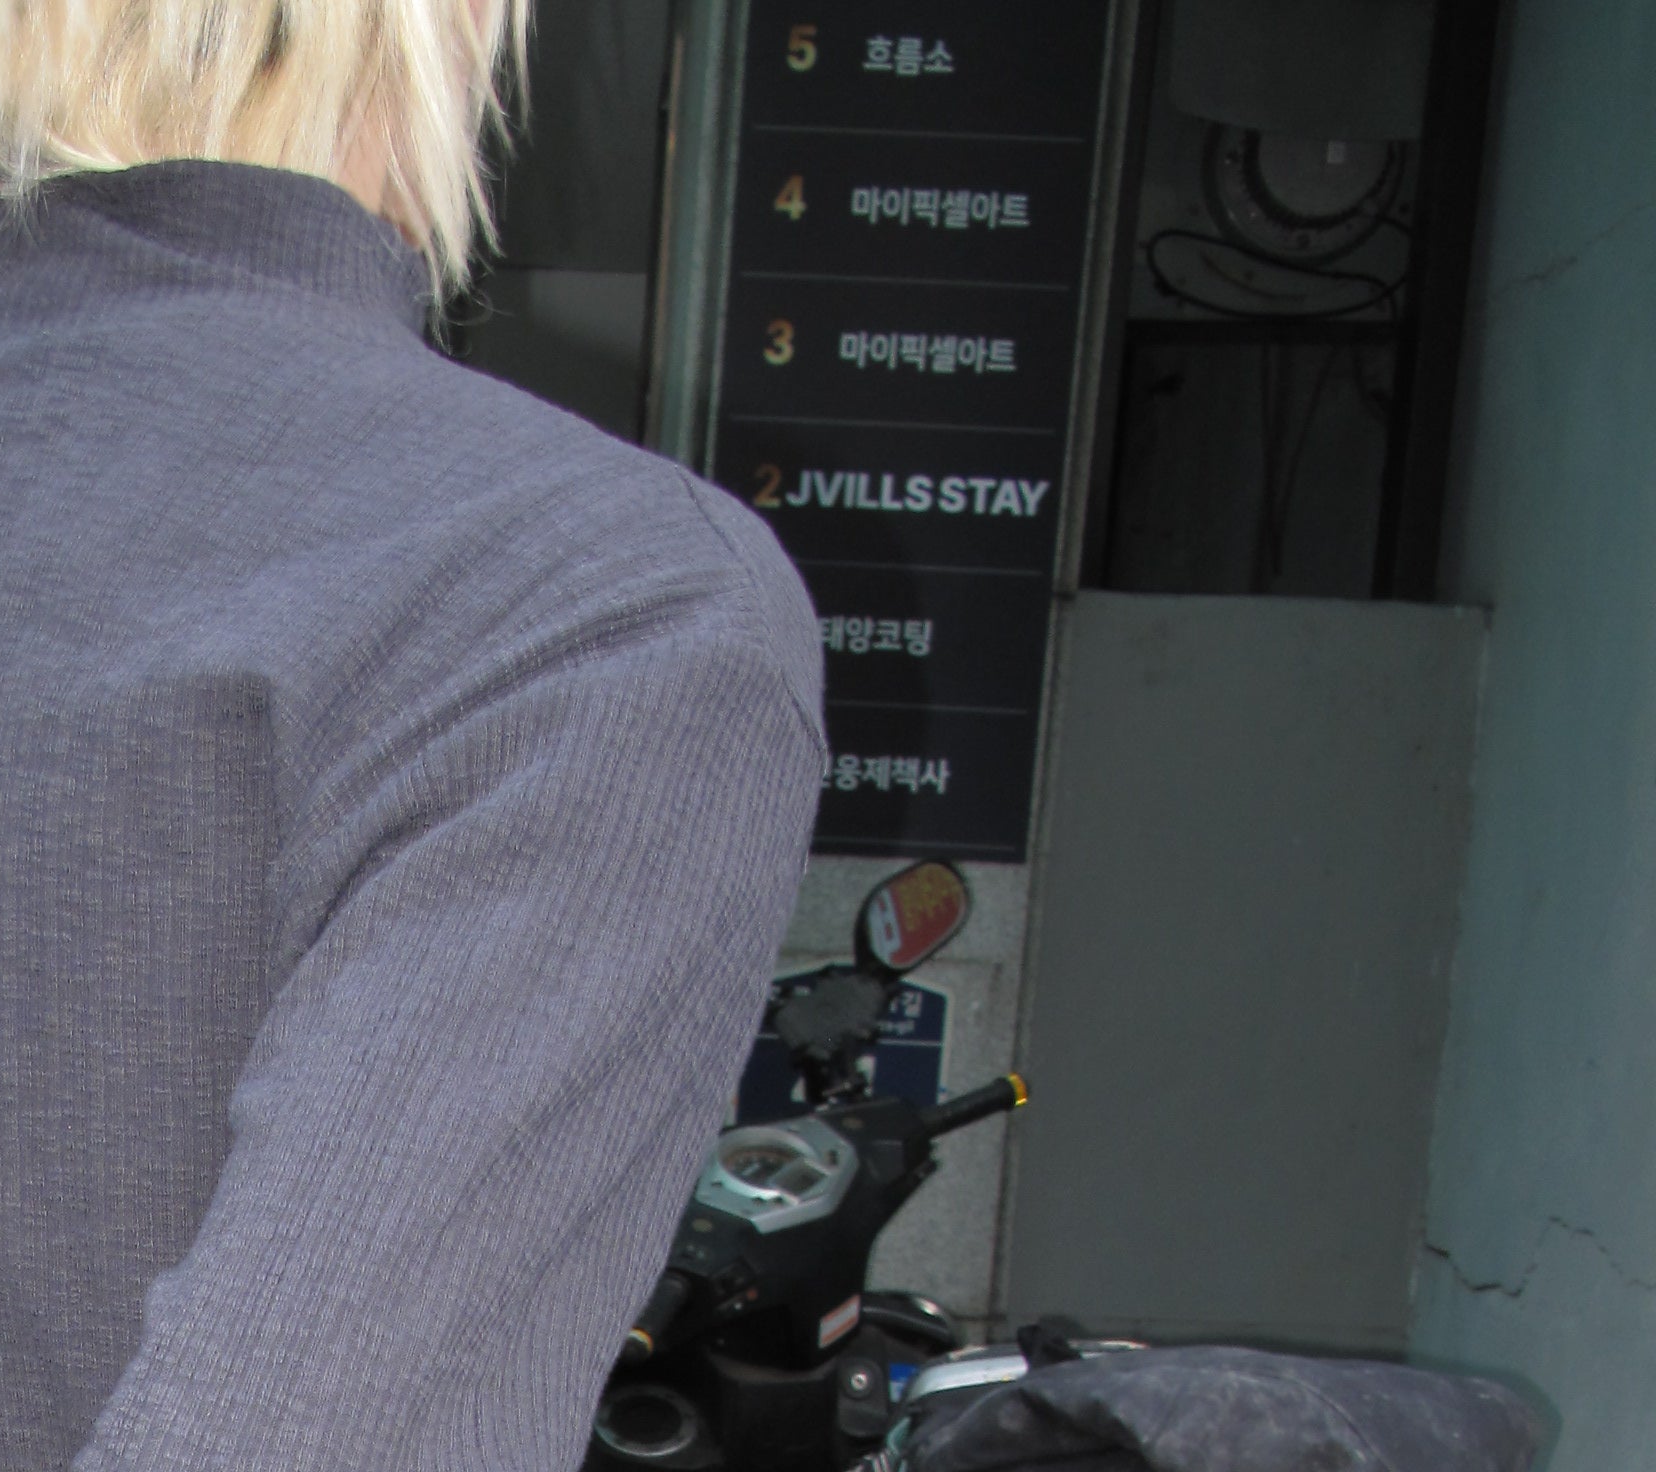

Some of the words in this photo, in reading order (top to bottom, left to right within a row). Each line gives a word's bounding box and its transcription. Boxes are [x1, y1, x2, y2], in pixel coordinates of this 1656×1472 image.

[785, 24, 819, 72] 5
[861, 33, 956, 78] 흐름소
[773, 174, 809, 222] 4
[850, 184, 1032, 230] 마이픽셀아트
[762, 317, 796, 366] 3
[838, 330, 1018, 375] 마이픽셀아트
[752, 463, 782, 509] 2
[817, 614, 934, 658] 태양코팅
